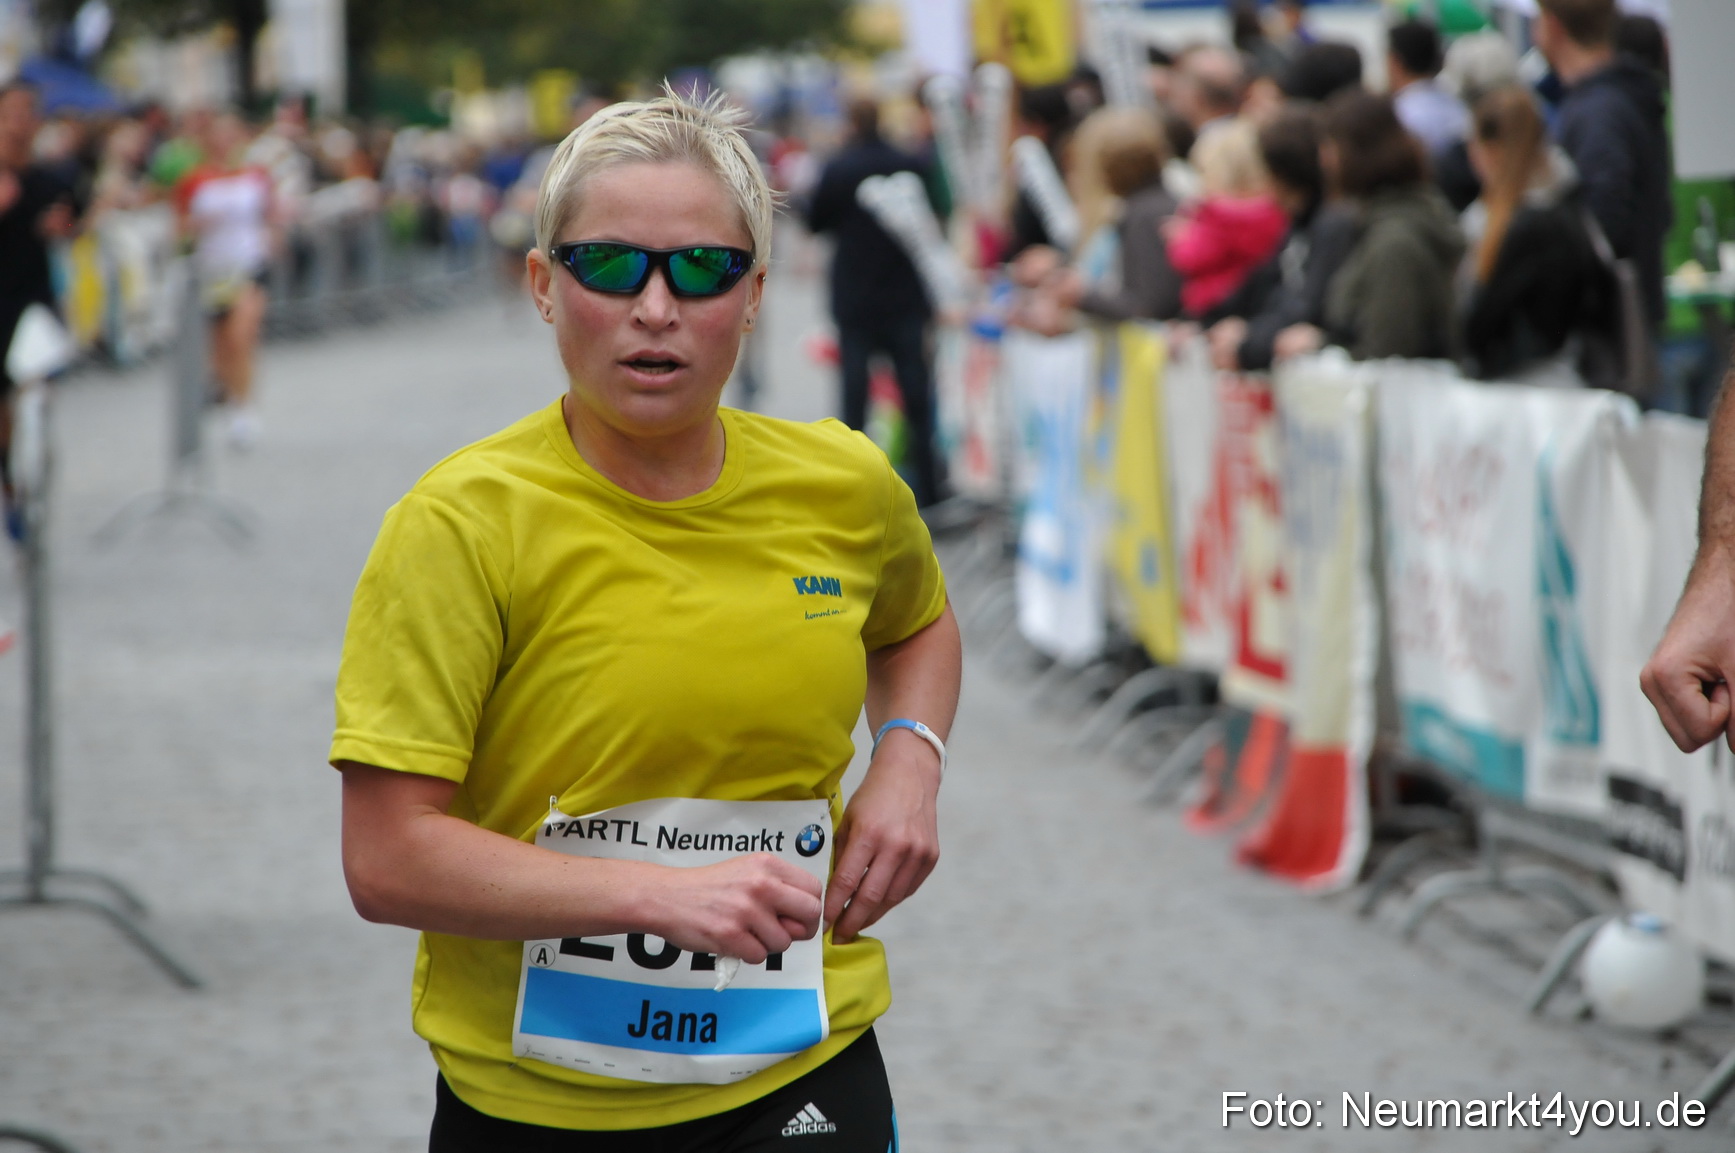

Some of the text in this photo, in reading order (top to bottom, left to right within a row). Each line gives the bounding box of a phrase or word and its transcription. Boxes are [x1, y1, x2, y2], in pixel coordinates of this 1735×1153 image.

[792, 575, 842, 597] KANN
[545, 819, 785, 852] PARTL Neumarkt
[536, 948, 548, 965] A
[627, 999, 718, 1044] Jana
[781, 1120, 837, 1137] adidas
